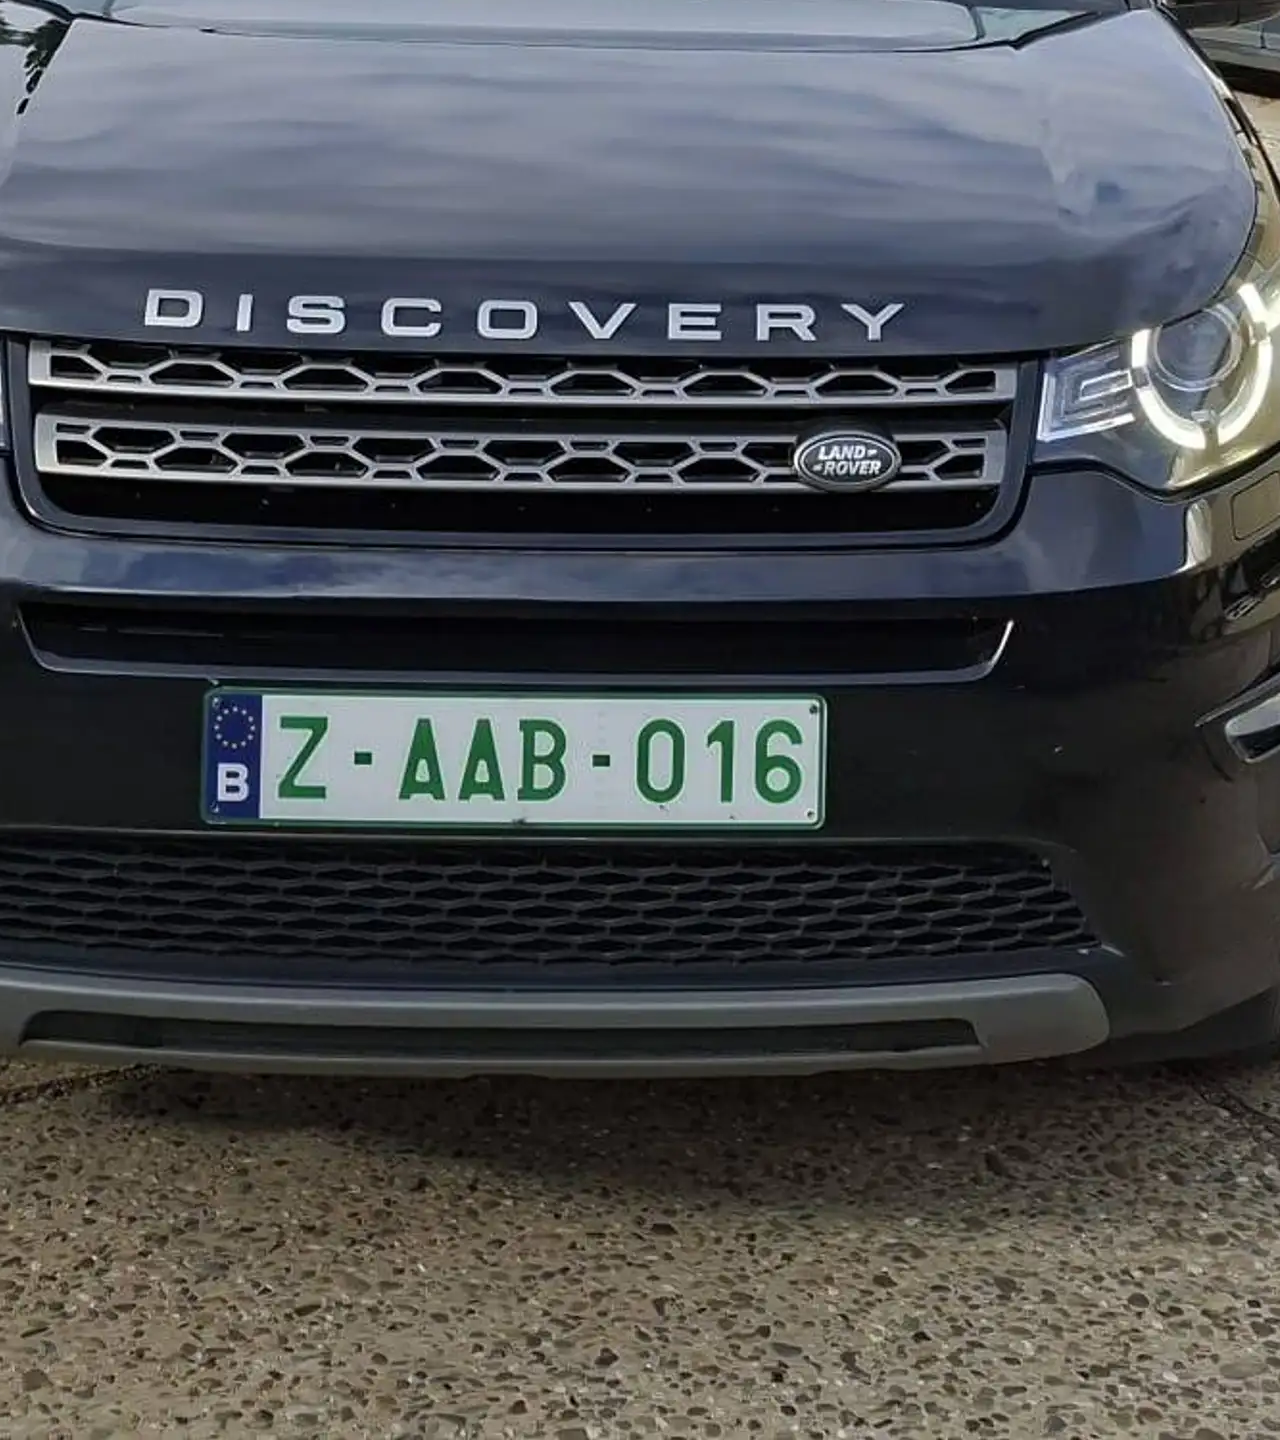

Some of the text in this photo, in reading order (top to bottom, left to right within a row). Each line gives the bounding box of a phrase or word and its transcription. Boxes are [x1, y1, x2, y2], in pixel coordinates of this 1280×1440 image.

[144, 289, 905, 341] DISCOVERY
[216, 716, 804, 805] B Z-AAB-016
